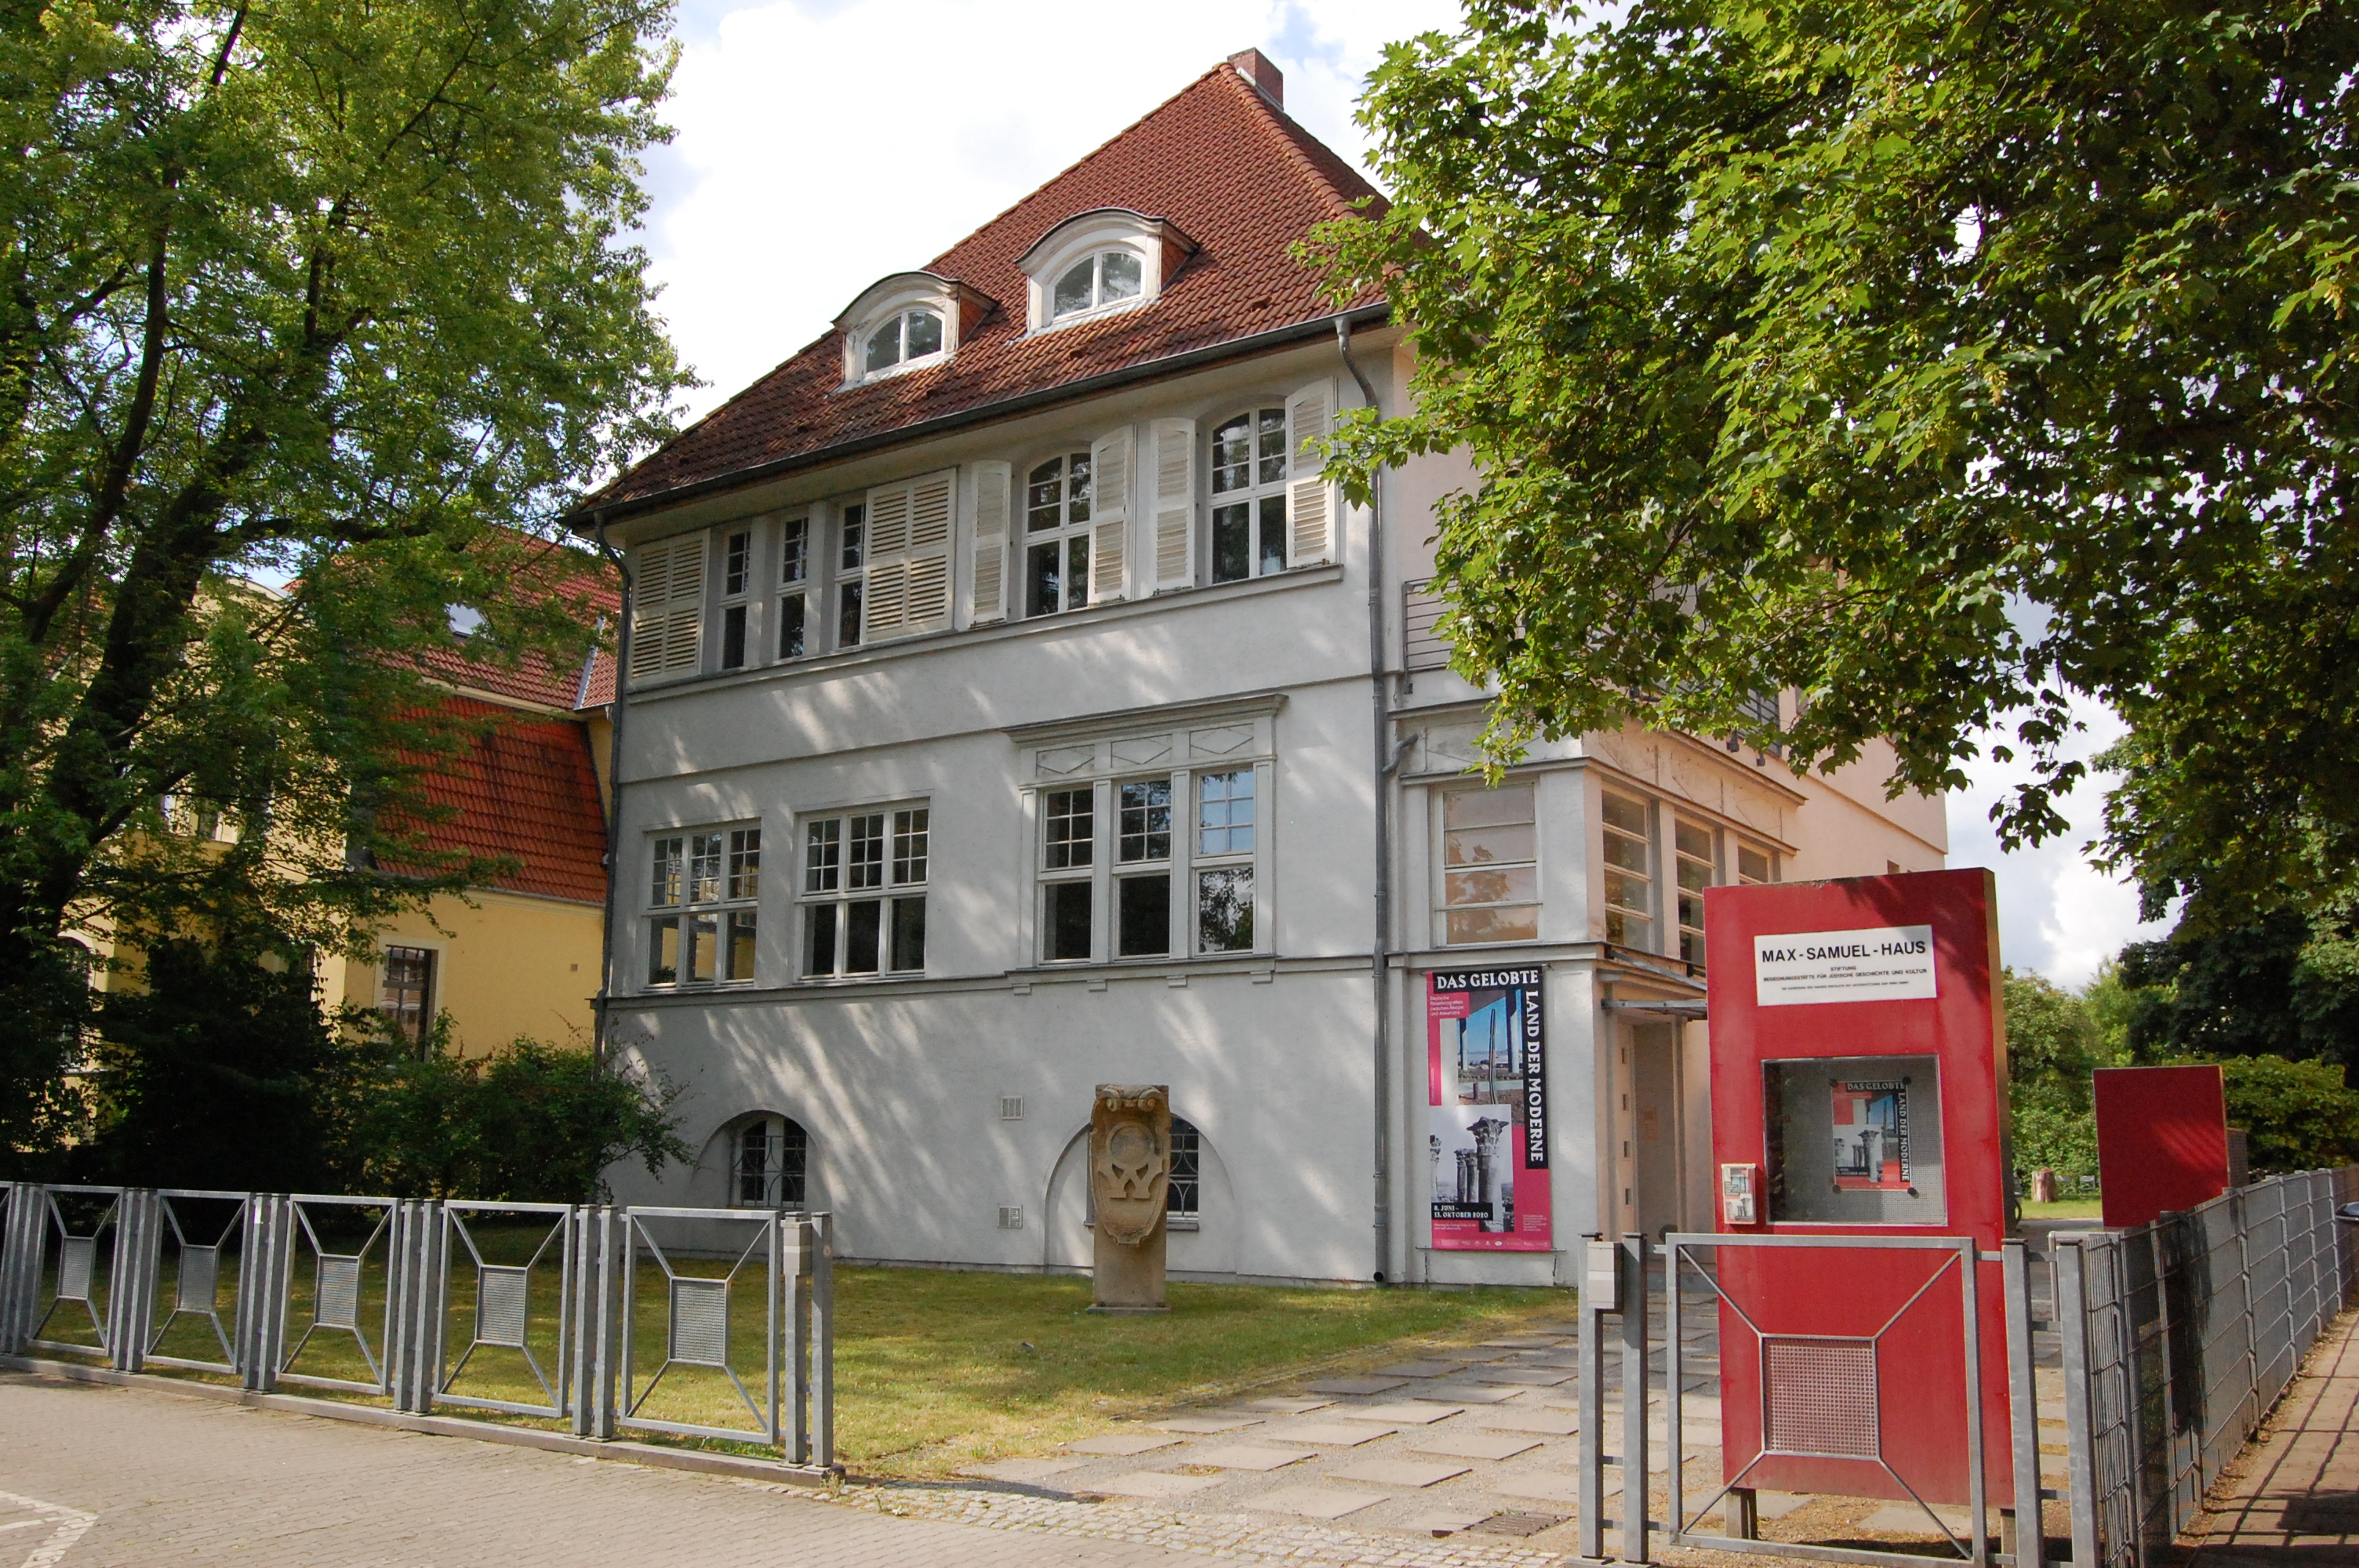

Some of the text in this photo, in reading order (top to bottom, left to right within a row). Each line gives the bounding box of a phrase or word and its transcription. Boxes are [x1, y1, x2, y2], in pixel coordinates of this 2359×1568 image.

[1437, 970, 1539, 989] DAS GELOBTE
[1525, 990, 1543, 1162] LAND DER MODERNE
[1866, 1082, 1906, 1091] GELOBTE
[1898, 1092, 1909, 1181] LAND DER MODERNE
